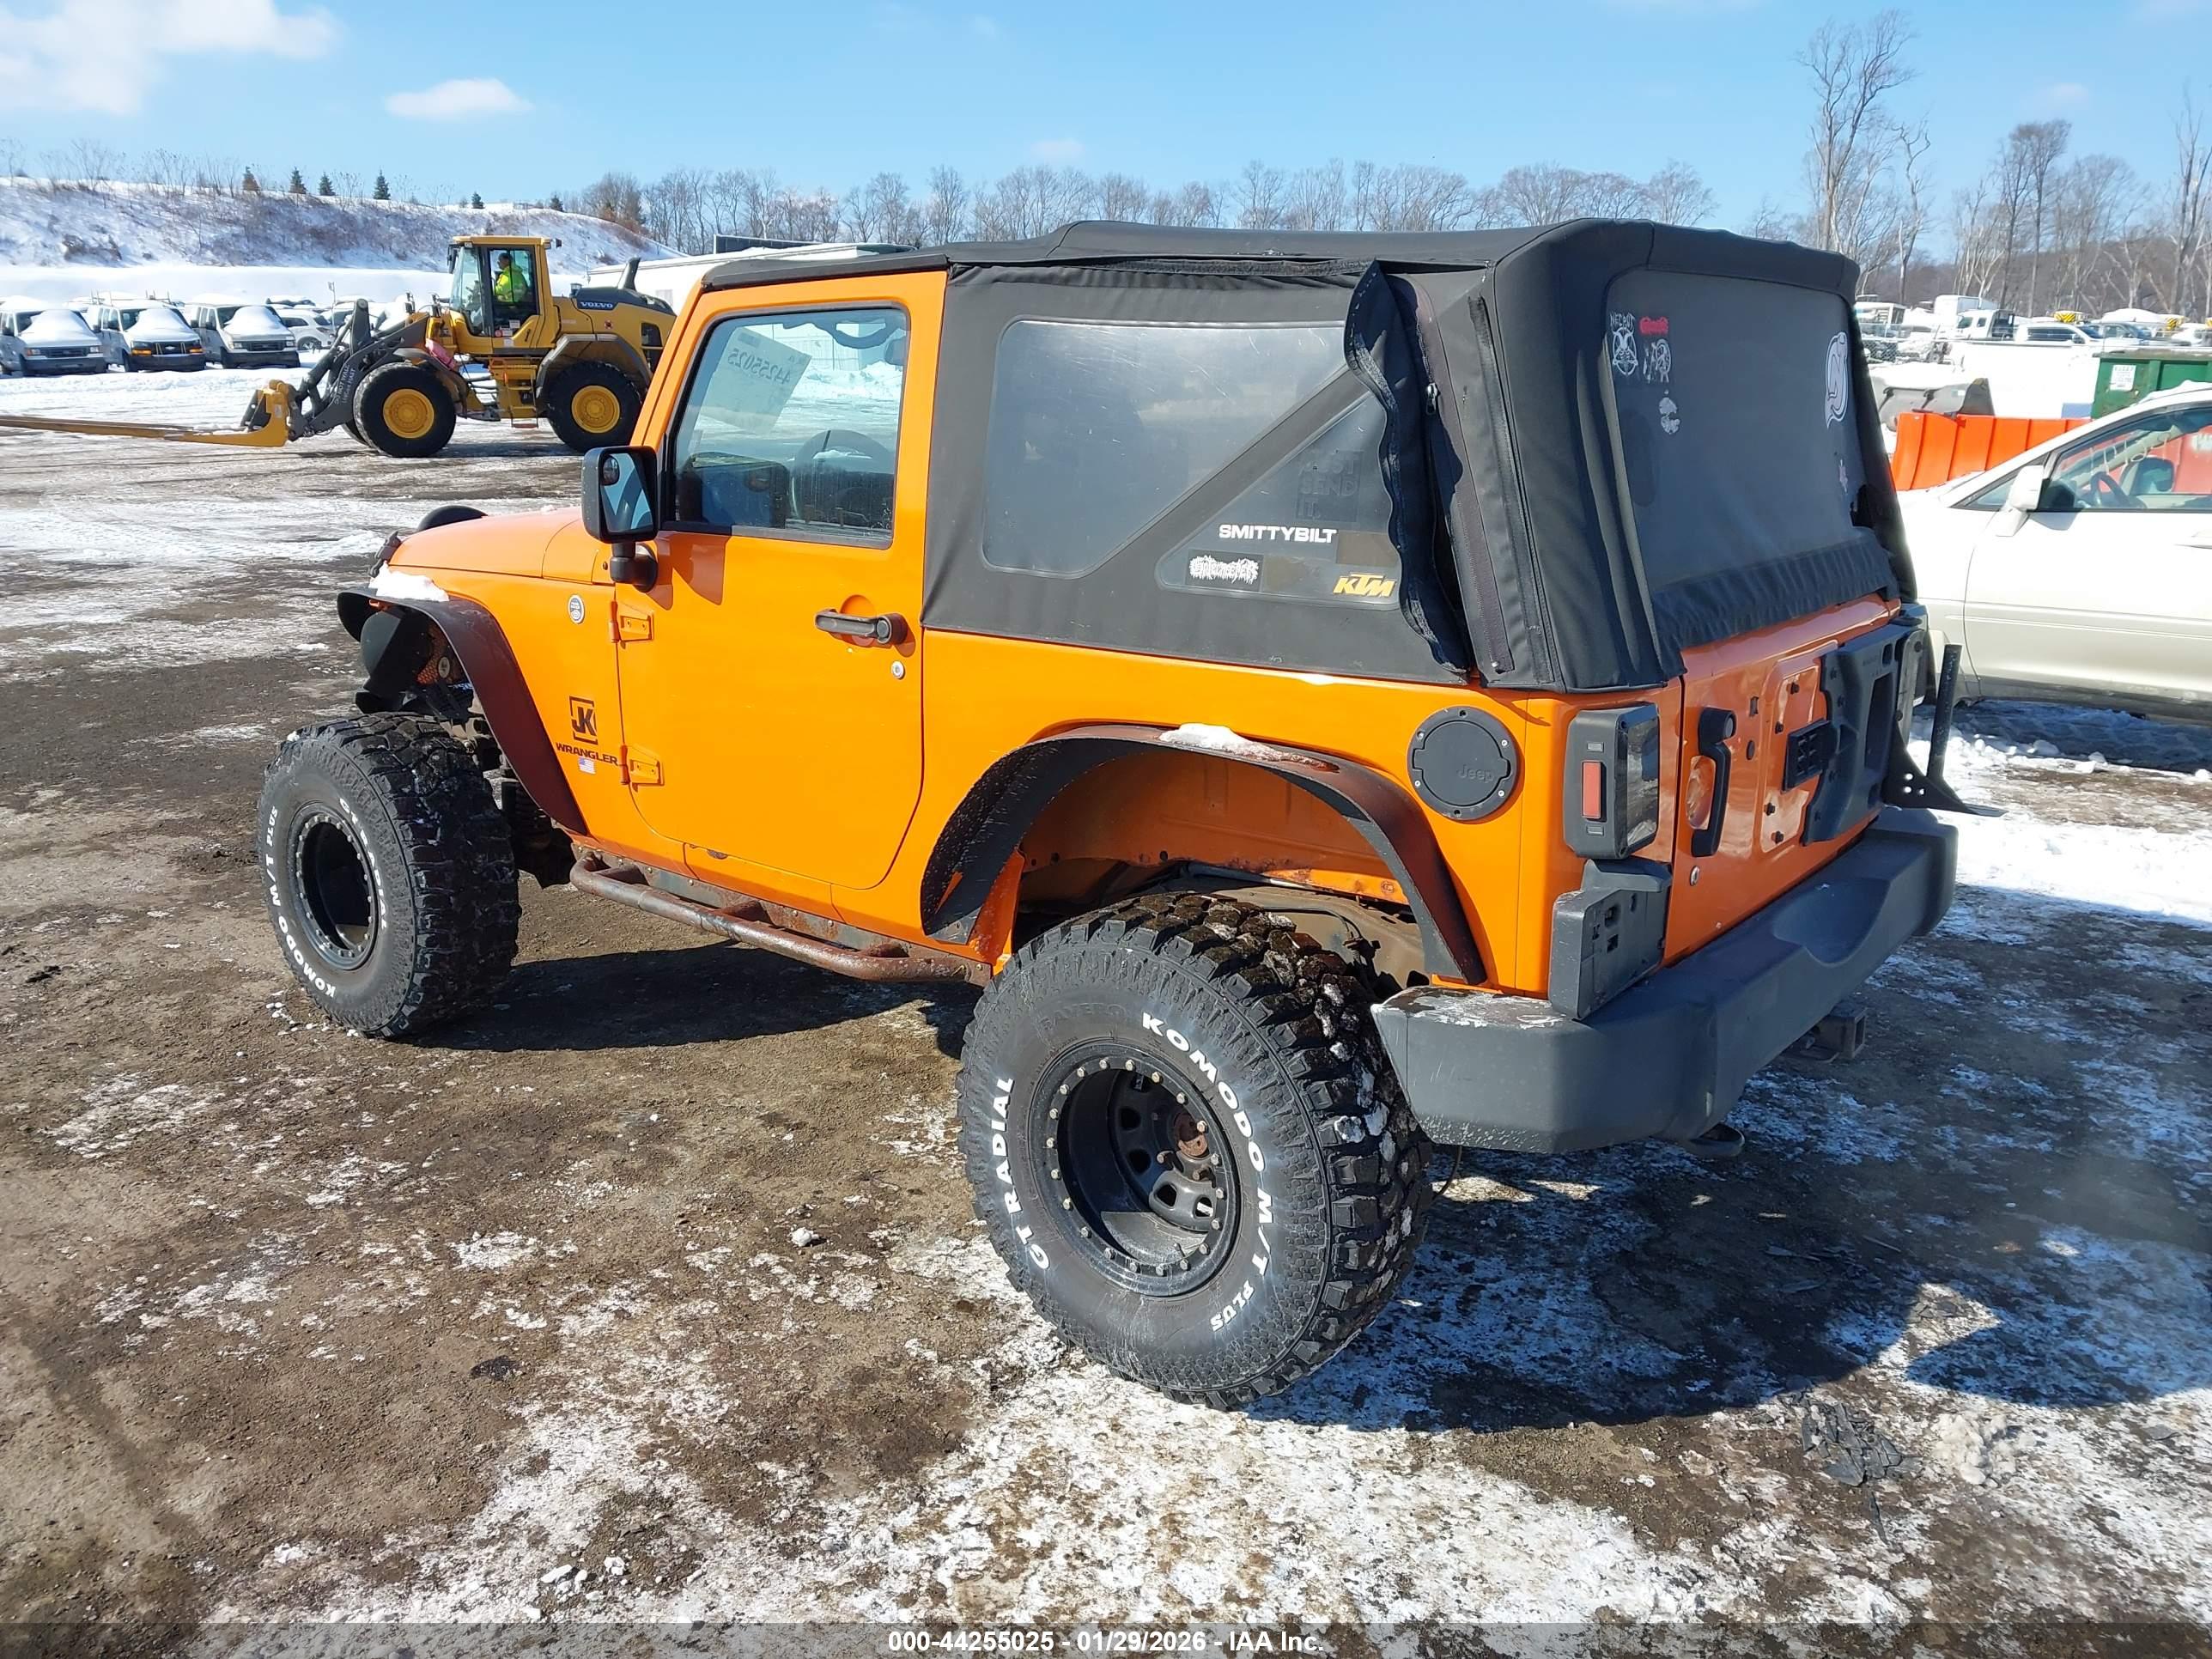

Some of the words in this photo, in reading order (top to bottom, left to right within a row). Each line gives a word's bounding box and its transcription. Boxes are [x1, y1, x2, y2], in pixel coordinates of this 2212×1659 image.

[1218, 525, 1337, 544] SMITTYBILT
[1333, 573, 1398, 597] KTM
[571, 706, 597, 736] JK
[556, 742, 619, 766] WRANGLER
[1457, 764, 1494, 783] Jeep
[266, 805, 278, 847] PLUS
[265, 854, 281, 907] M/T
[339, 798, 357, 824] GT
[361, 830, 387, 928] RADIAL
[278, 915, 337, 998] KOMODO
[1141, 1012, 1265, 1172] KOMODO
[992, 1078, 1022, 1215] RADIAL
[1018, 1225, 1050, 1270] GT
[1251, 1188, 1273, 1277] M/T
[1210, 1279, 1255, 1332] PLUS
